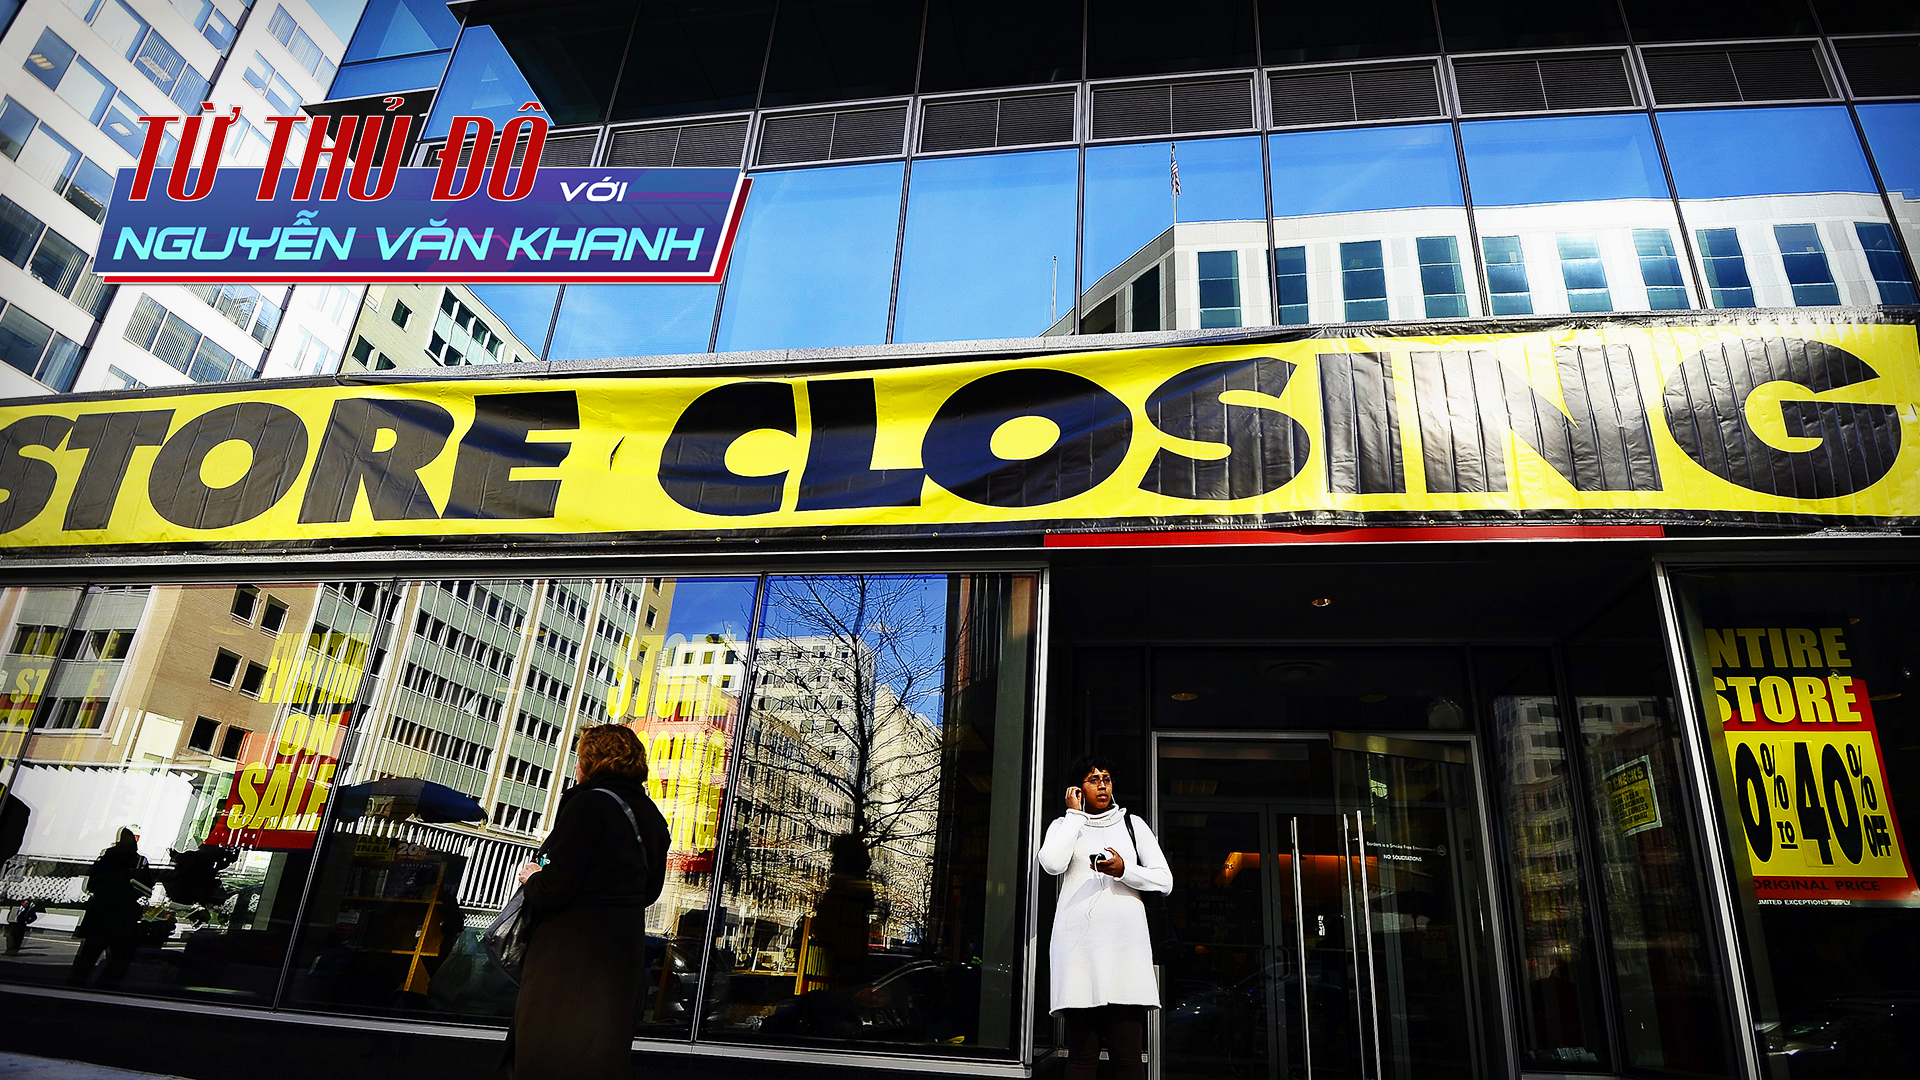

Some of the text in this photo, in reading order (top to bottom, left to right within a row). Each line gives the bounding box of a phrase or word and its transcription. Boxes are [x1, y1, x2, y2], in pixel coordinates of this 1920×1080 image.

[0, 337, 1901, 534] STORE CLOSING
[1705, 628, 1852, 668] NTIRE
[279, 713, 341, 756] ON
[227, 762, 336, 830] SALE
[1613, 766, 1644, 789] CHECKS
[1735, 742, 1892, 866] 0% TO 40% OFF
[1754, 880, 1882, 892] ORIGINAL PRICE
